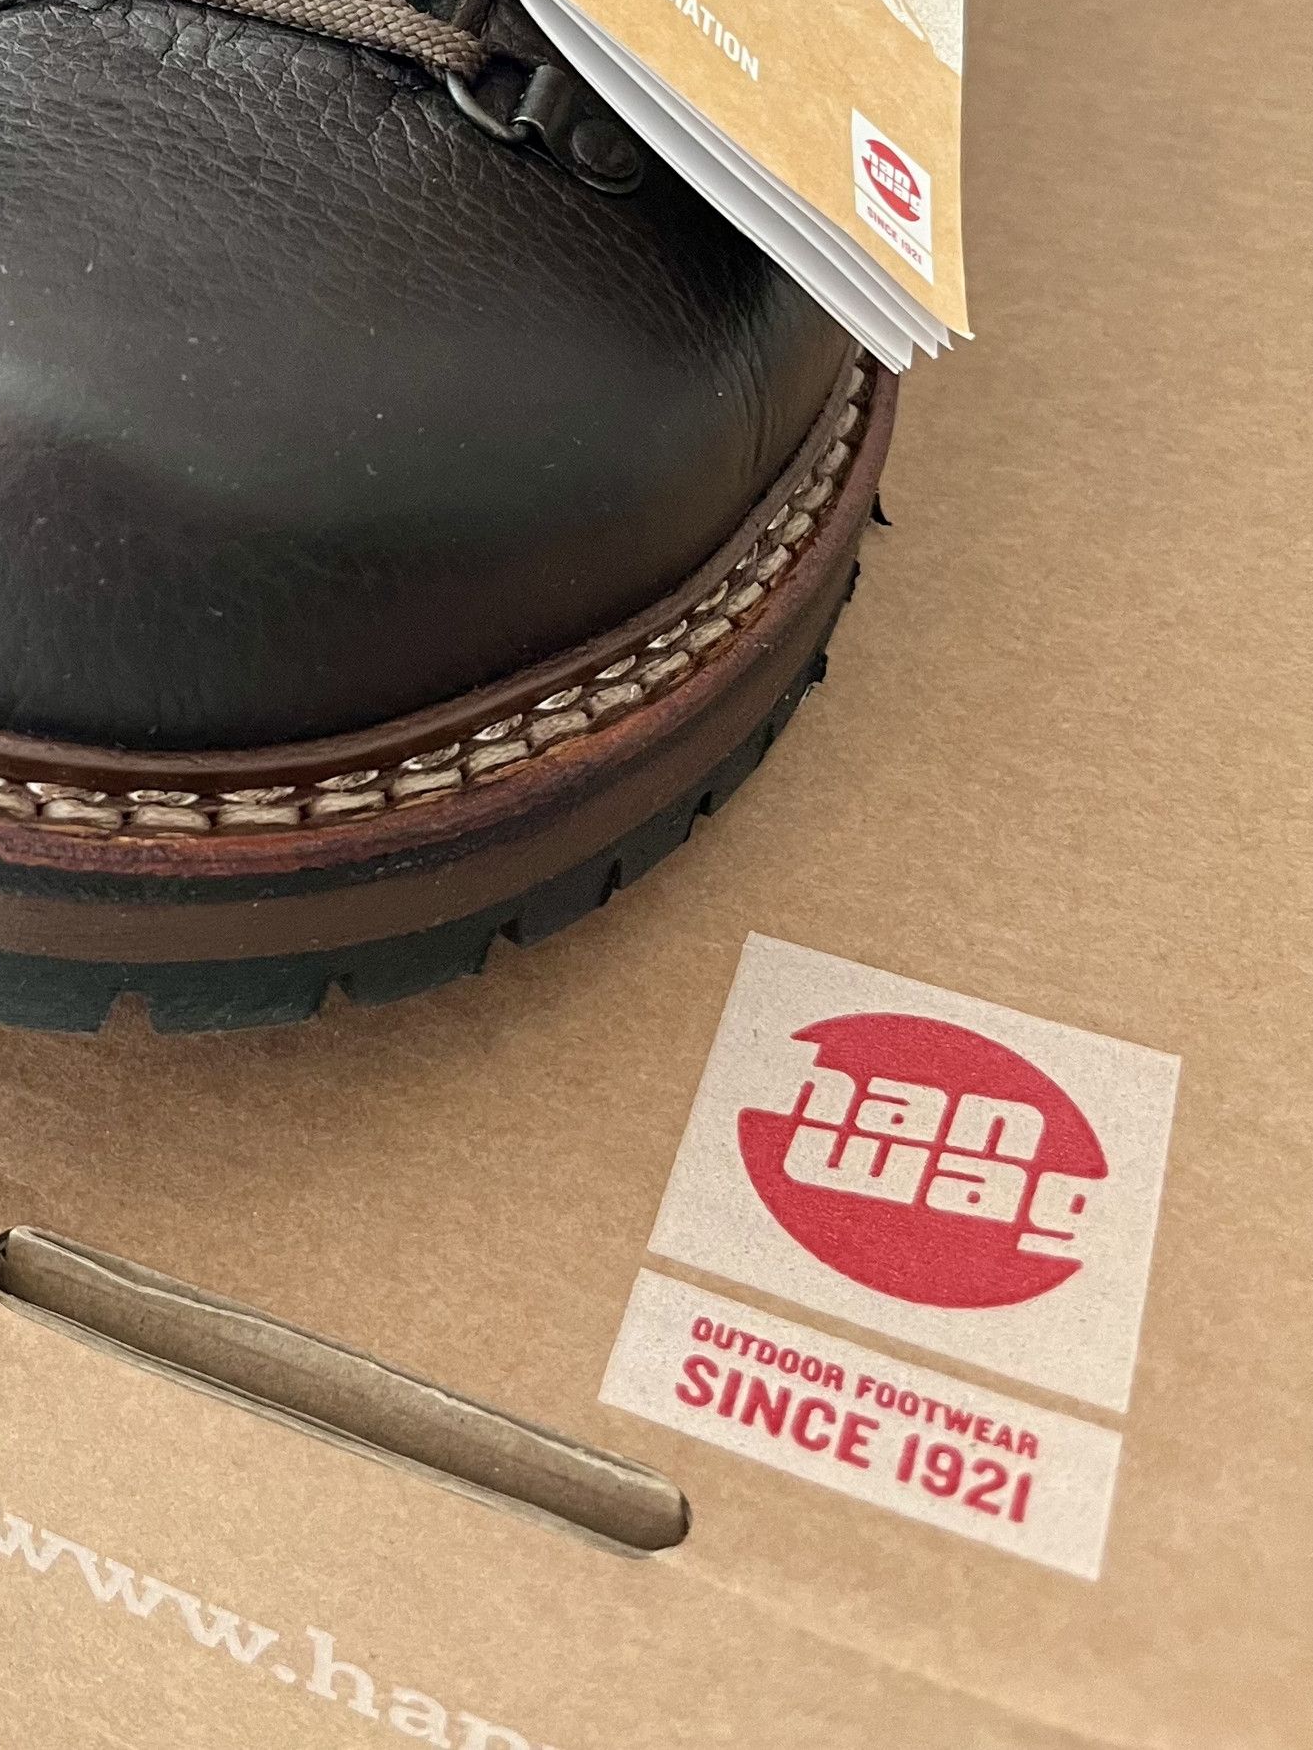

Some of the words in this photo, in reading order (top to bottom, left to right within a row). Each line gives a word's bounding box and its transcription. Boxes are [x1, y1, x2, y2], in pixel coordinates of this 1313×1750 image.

[867, 206, 898, 243] SINCE
[901, 238, 923, 265] 1921
[675, 1354, 880, 1469] SINCE
[896, 1432, 1033, 1524] 1921
[691, 1316, 844, 1392] OUTDOOR
[855, 1375, 1040, 1460] FOOTWEAR
